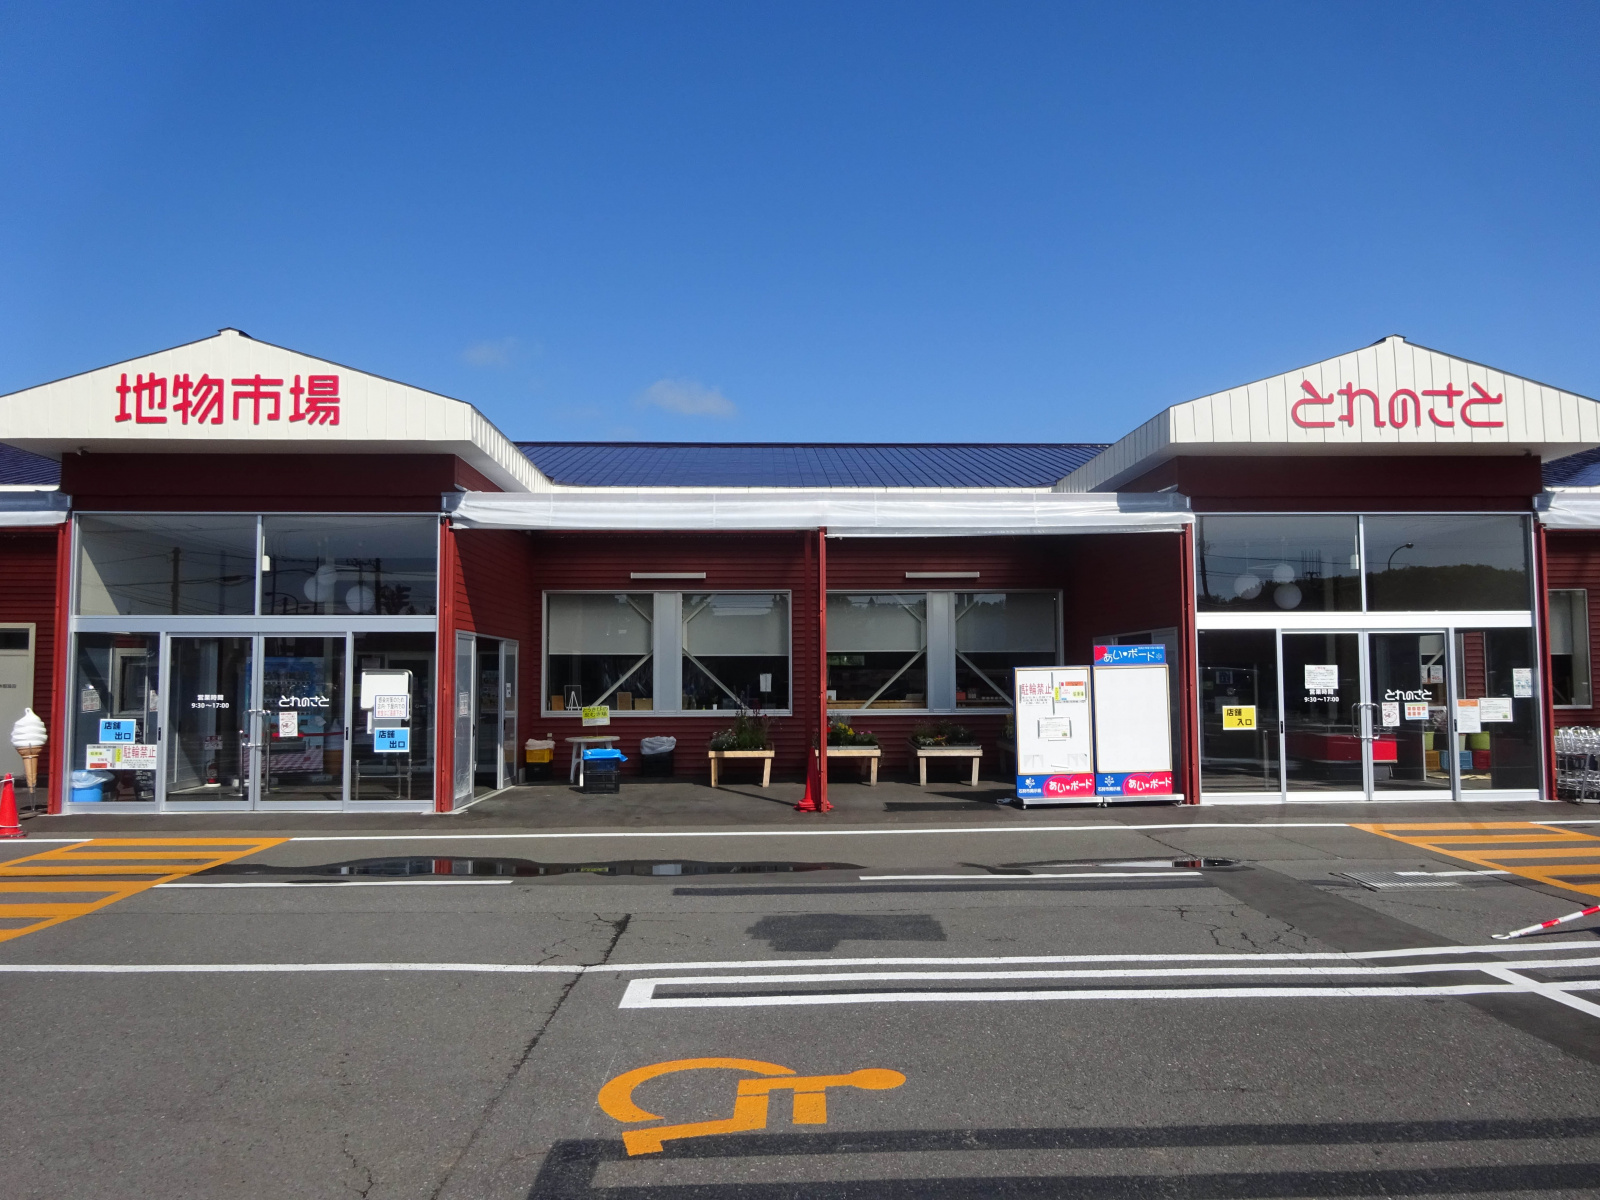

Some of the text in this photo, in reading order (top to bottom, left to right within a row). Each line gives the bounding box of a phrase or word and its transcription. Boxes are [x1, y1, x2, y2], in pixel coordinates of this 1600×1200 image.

[114, 372, 341, 426] 地物市場
[1291, 379, 1504, 429] とれのさと
[1021, 683, 1052, 695] 駐輪禁止
[1384, 689, 1433, 701] とれのさと
[278, 695, 330, 708] とれのさと
[1226, 708, 1242, 717] 店舗
[104, 721, 121, 730] 店舗
[1237, 718, 1253, 726] 入口
[115, 732, 131, 740] 出口
[378, 730, 395, 739] 店舗
[123, 745, 156, 759] 駐輪禁止
